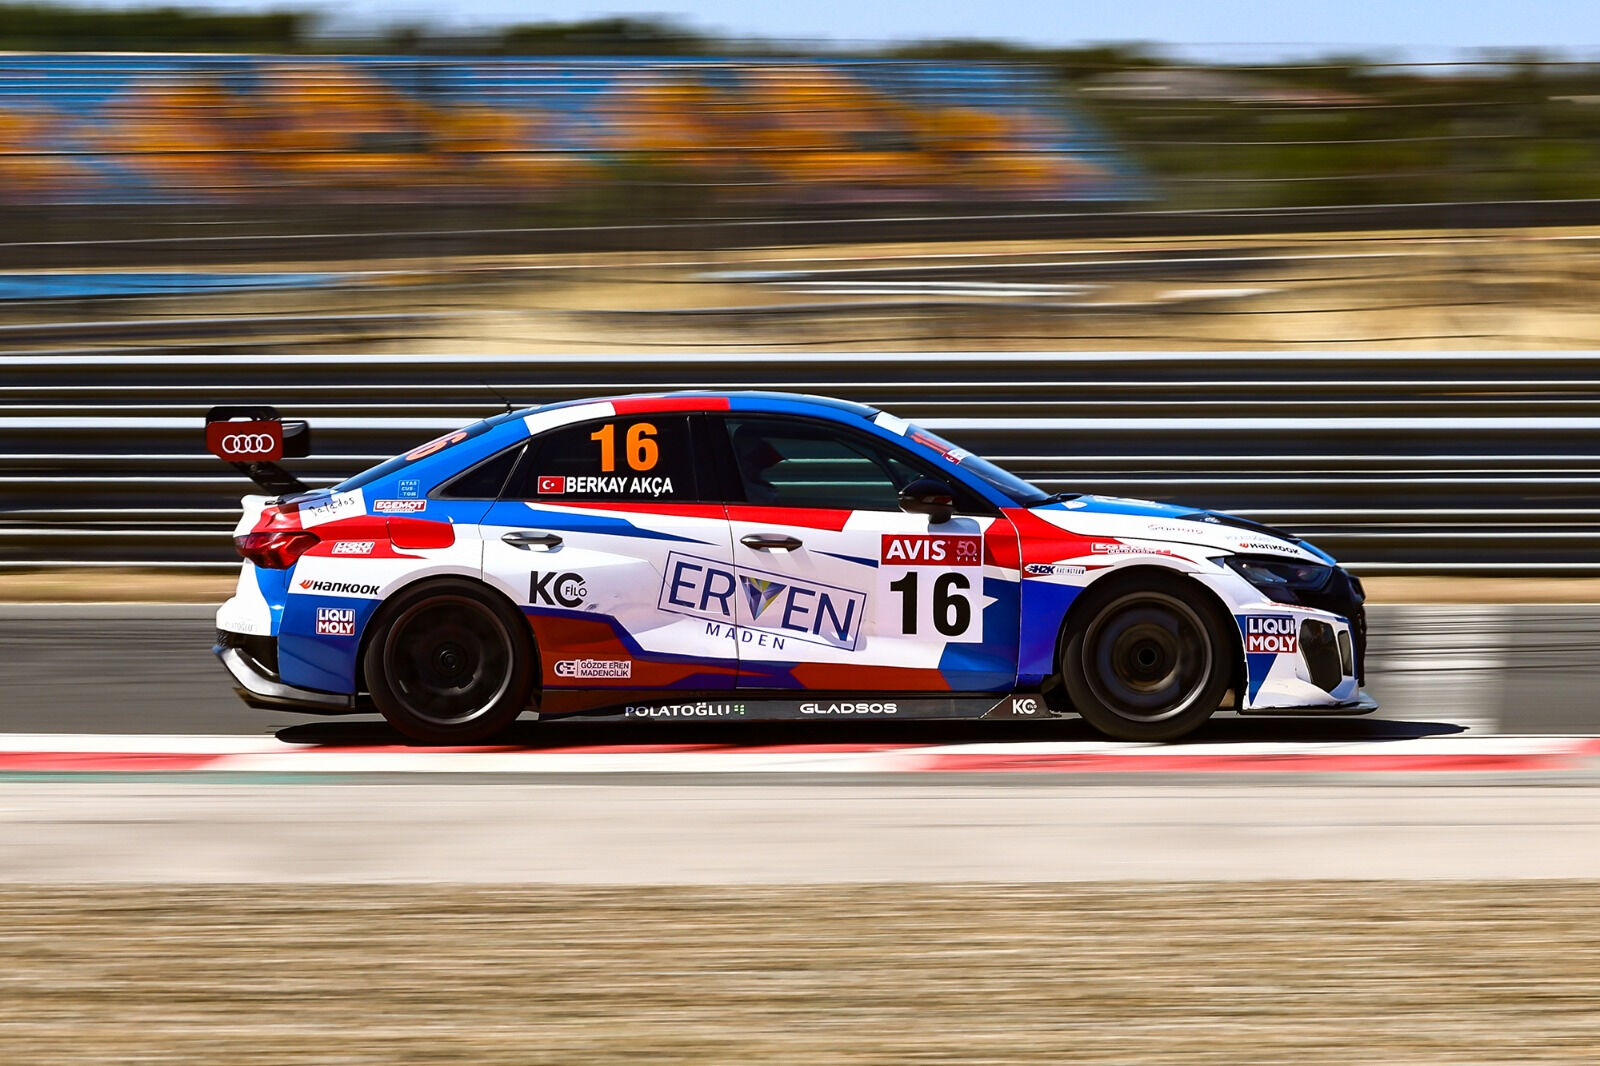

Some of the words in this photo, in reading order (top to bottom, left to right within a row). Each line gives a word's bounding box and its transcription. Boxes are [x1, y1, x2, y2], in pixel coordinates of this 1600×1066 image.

[590, 422, 659, 473] 16
[566, 476, 628, 493] BERKAY
[630, 476, 673, 496] AKÇA
[376, 501, 424, 509] EGEMOT
[886, 539, 946, 561] AVIS
[668, 560, 856, 642] ERVEN
[890, 571, 971, 637] 16
[318, 609, 353, 622] LIQUI
[318, 621, 353, 634] MOLY
[1248, 618, 1296, 634] LIQUI
[705, 622, 786, 651] MADEN
[1248, 635, 1297, 652] MOLY
[580, 661, 607, 669] GÖZDE
[580, 668, 629, 677] MADENCİLİK
[800, 703, 898, 714] GLADSOS
